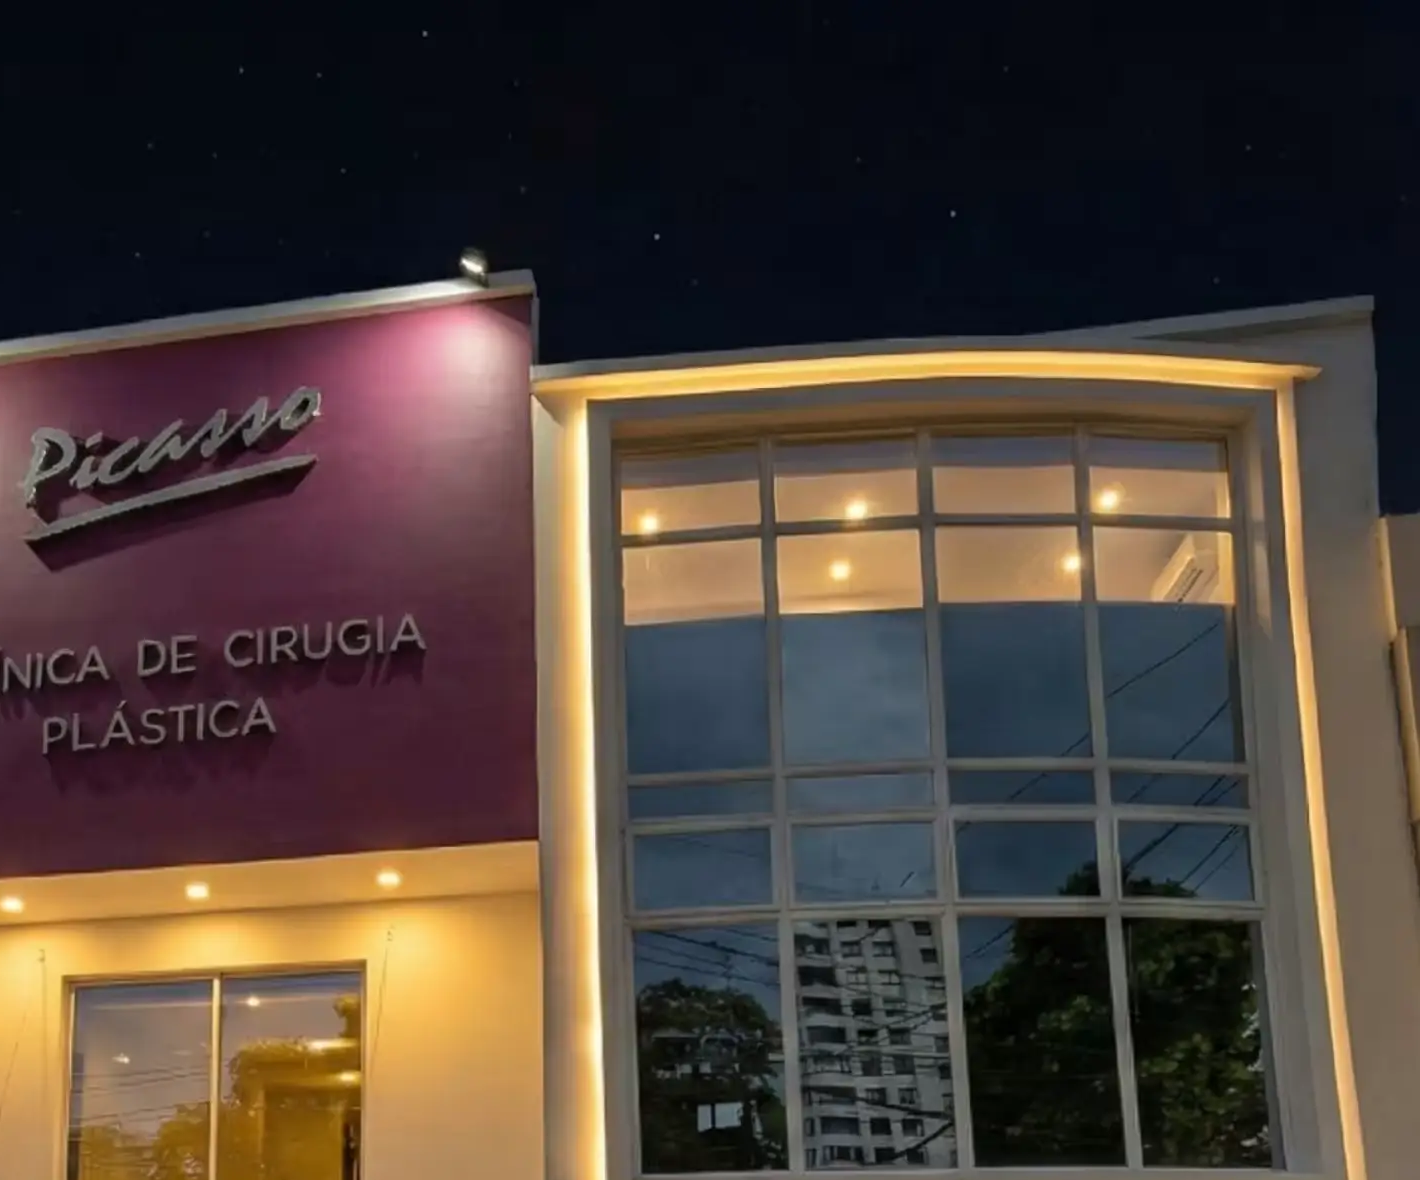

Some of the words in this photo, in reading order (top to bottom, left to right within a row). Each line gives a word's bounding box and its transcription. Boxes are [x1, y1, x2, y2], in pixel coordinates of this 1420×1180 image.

[18, 385, 324, 507] Picasso
[136, 633, 198, 678] DE
[223, 612, 427, 667] CIRUGIA
[41, 696, 277, 755] PLÁSTICA
